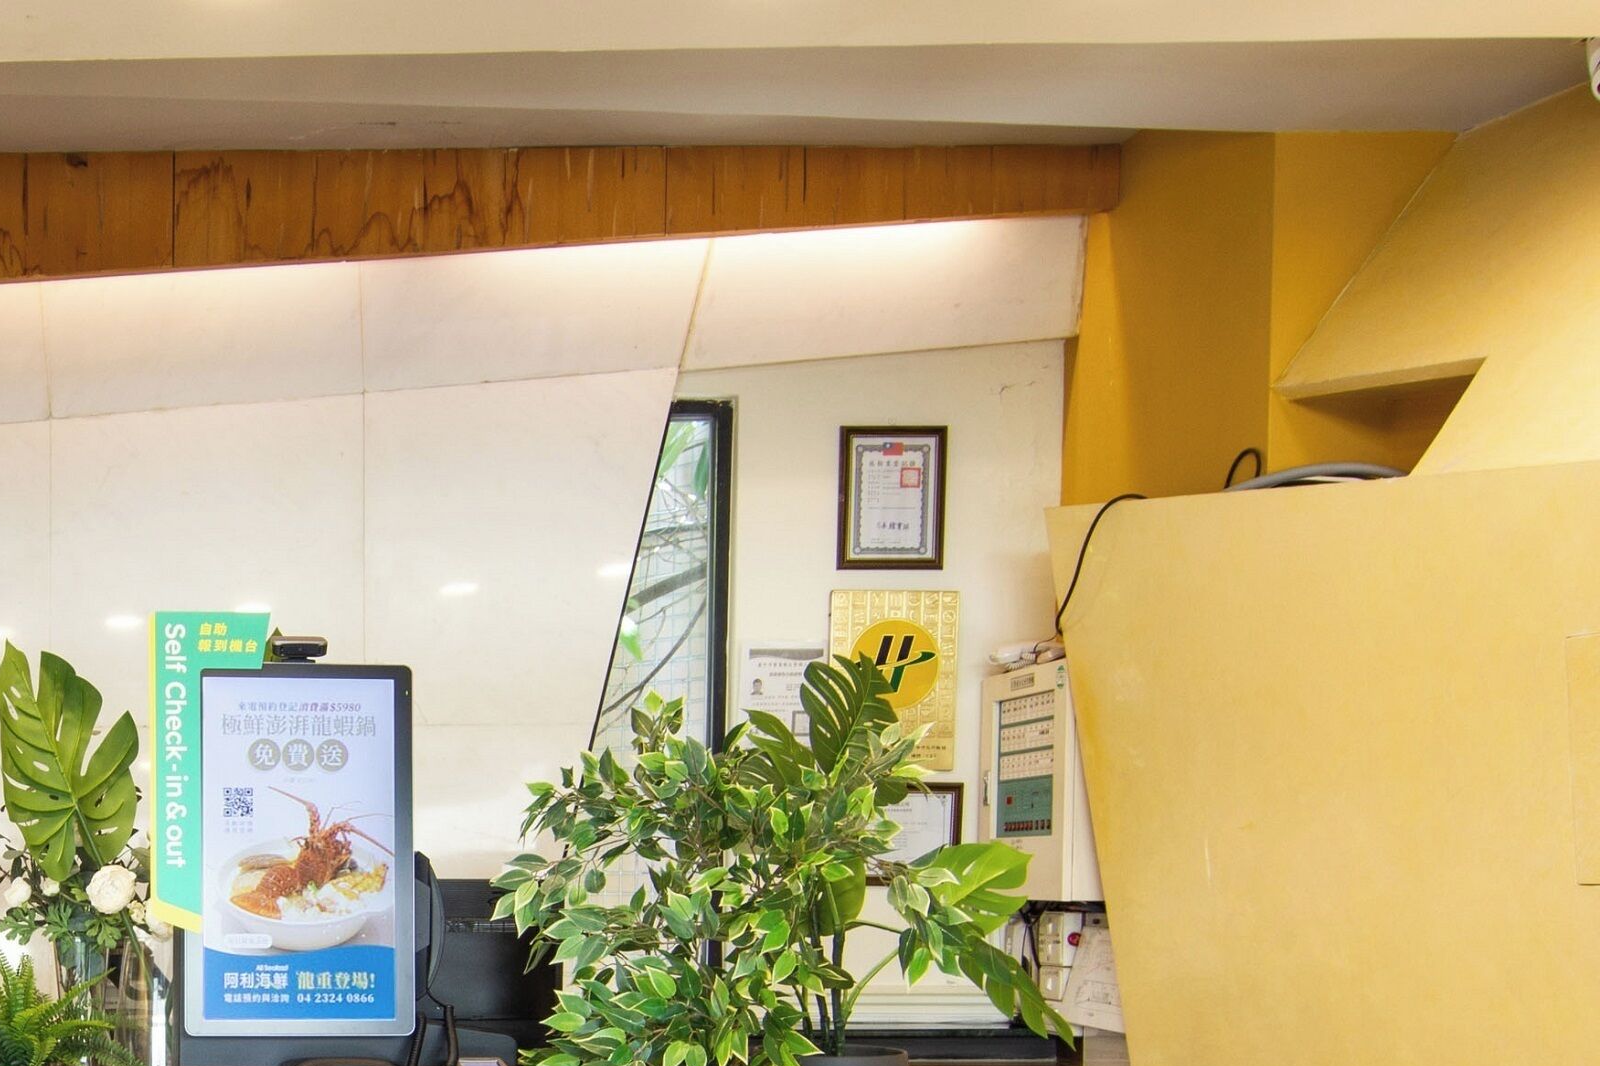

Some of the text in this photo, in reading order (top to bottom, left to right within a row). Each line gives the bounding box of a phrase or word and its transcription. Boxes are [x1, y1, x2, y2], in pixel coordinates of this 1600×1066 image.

[200, 622, 228, 636] 自助
[197, 638, 258, 653] 報到機台
[222, 713, 377, 737] 極鮮澎湃龍蝦鍋
[164, 623, 189, 868] Self Check-in & out
[253, 744, 343, 766] 免費送
[223, 970, 375, 990] 阿利海鮮 龍重登場!
[296, 993, 311, 1004] 04
[314, 993, 342, 1004] 2324
[346, 993, 375, 1004] 0866
